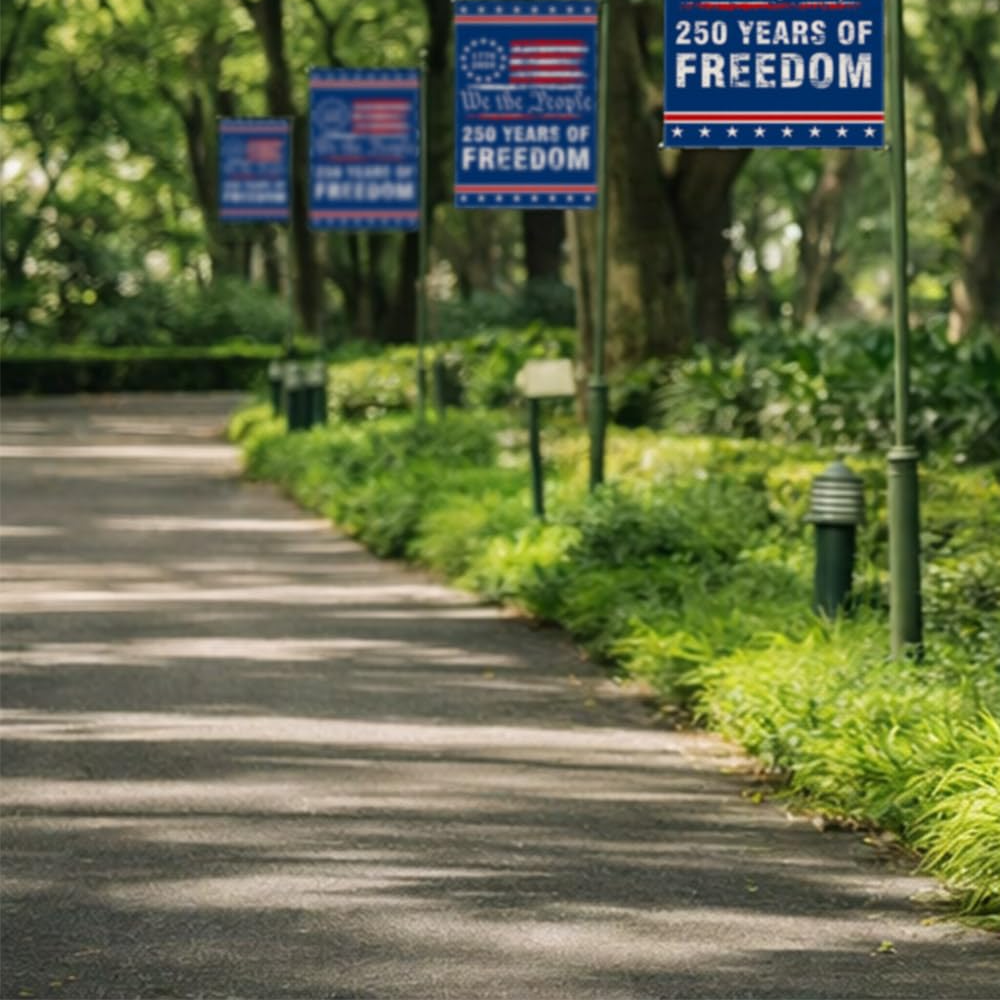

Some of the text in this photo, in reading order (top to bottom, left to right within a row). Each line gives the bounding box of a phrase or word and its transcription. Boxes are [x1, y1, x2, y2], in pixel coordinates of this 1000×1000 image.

[675, 20, 872, 45] 250 YEARS OF
[675, 53, 872, 89] FREEDOM
[462, 126, 590, 142] 250 YEARS OF
[462, 147, 590, 170] FREEDOM
